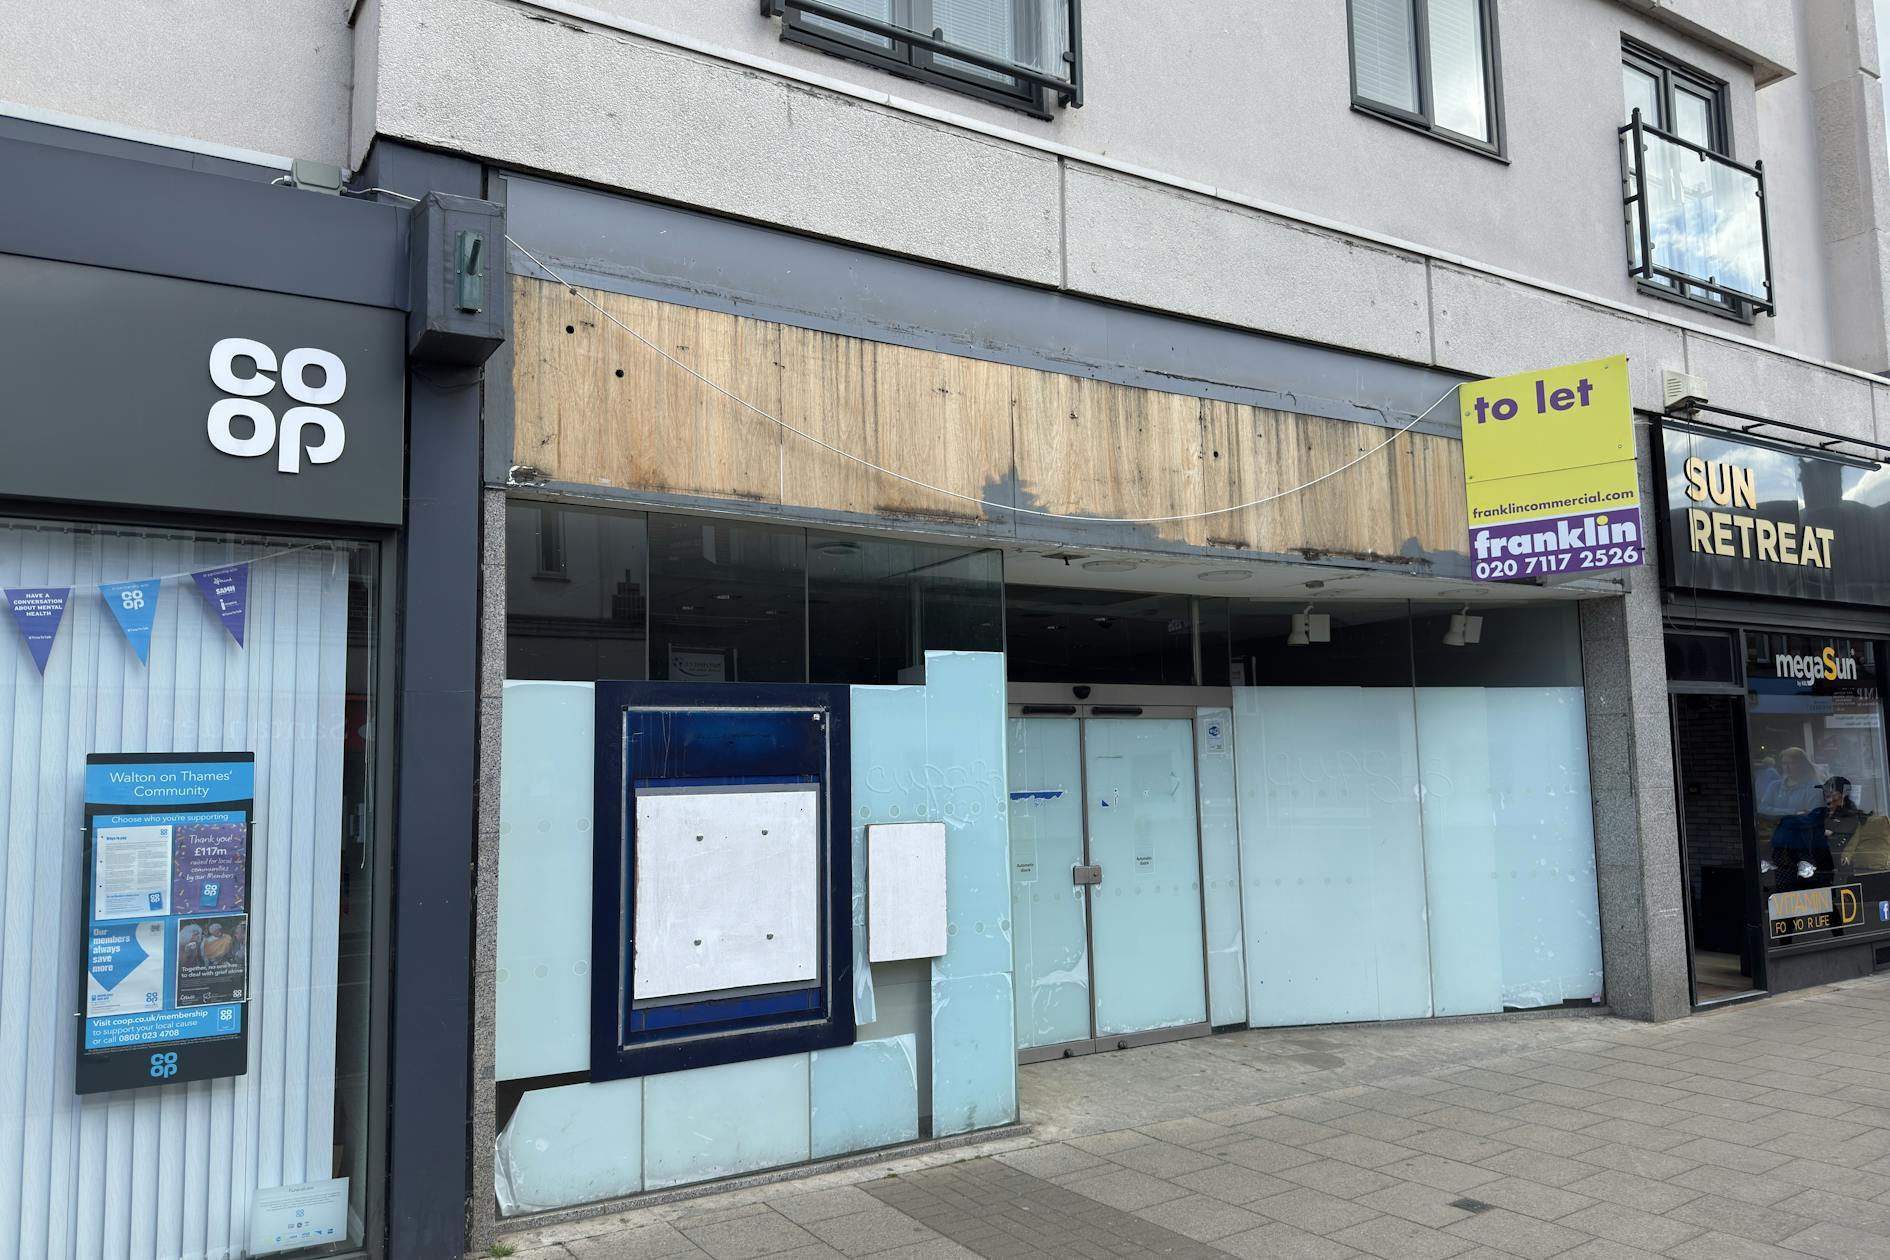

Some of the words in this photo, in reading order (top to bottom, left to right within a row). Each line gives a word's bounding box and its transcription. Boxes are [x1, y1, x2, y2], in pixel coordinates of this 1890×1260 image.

[1474, 396, 1519, 424] to
[1535, 378, 1593, 414] let
[1684, 456, 1757, 510] SUN
[1472, 489, 1634, 519] franklincommercial.com
[1474, 514, 1637, 559] franklin
[1687, 508, 1834, 569] RETREAT
[1475, 558, 1518, 579] 020
[1525, 553, 1571, 574] 7117
[1579, 546, 1639, 568] 2526
[1775, 646, 1858, 686] megaSun
[110, 771, 156, 783] Walton
[160, 773, 177, 782] on
[134, 784, 210, 798] Community
[111, 816, 142, 824] Choose
[162, 814, 186, 823] you're
[187, 813, 229, 822] supporting
[189, 834, 215, 844] Thank
[216, 834, 233, 846] you!
[194, 846, 227, 856] £117m
[1840, 888, 1857, 924] D
[1815, 915, 1831, 928] LIFE
[93, 928, 107, 936] Our
[93, 935, 131, 945] members
[92, 945, 121, 954] always
[92, 955, 112, 963] save
[92, 964, 114, 973] more
[93, 1019, 111, 1027] Visit
[112, 1009, 209, 1025] coop.co.uk/membership
[103, 1026, 135, 1036] support
[136, 1025, 154, 1033] your
[155, 1022, 174, 1030] local
[176, 1020, 198, 1028] cause
[103, 1036, 117, 1044] call
[119, 1034, 140, 1042] 0800
[142, 1031, 157, 1040] 023
[159, 1029, 180, 1038] 4708
